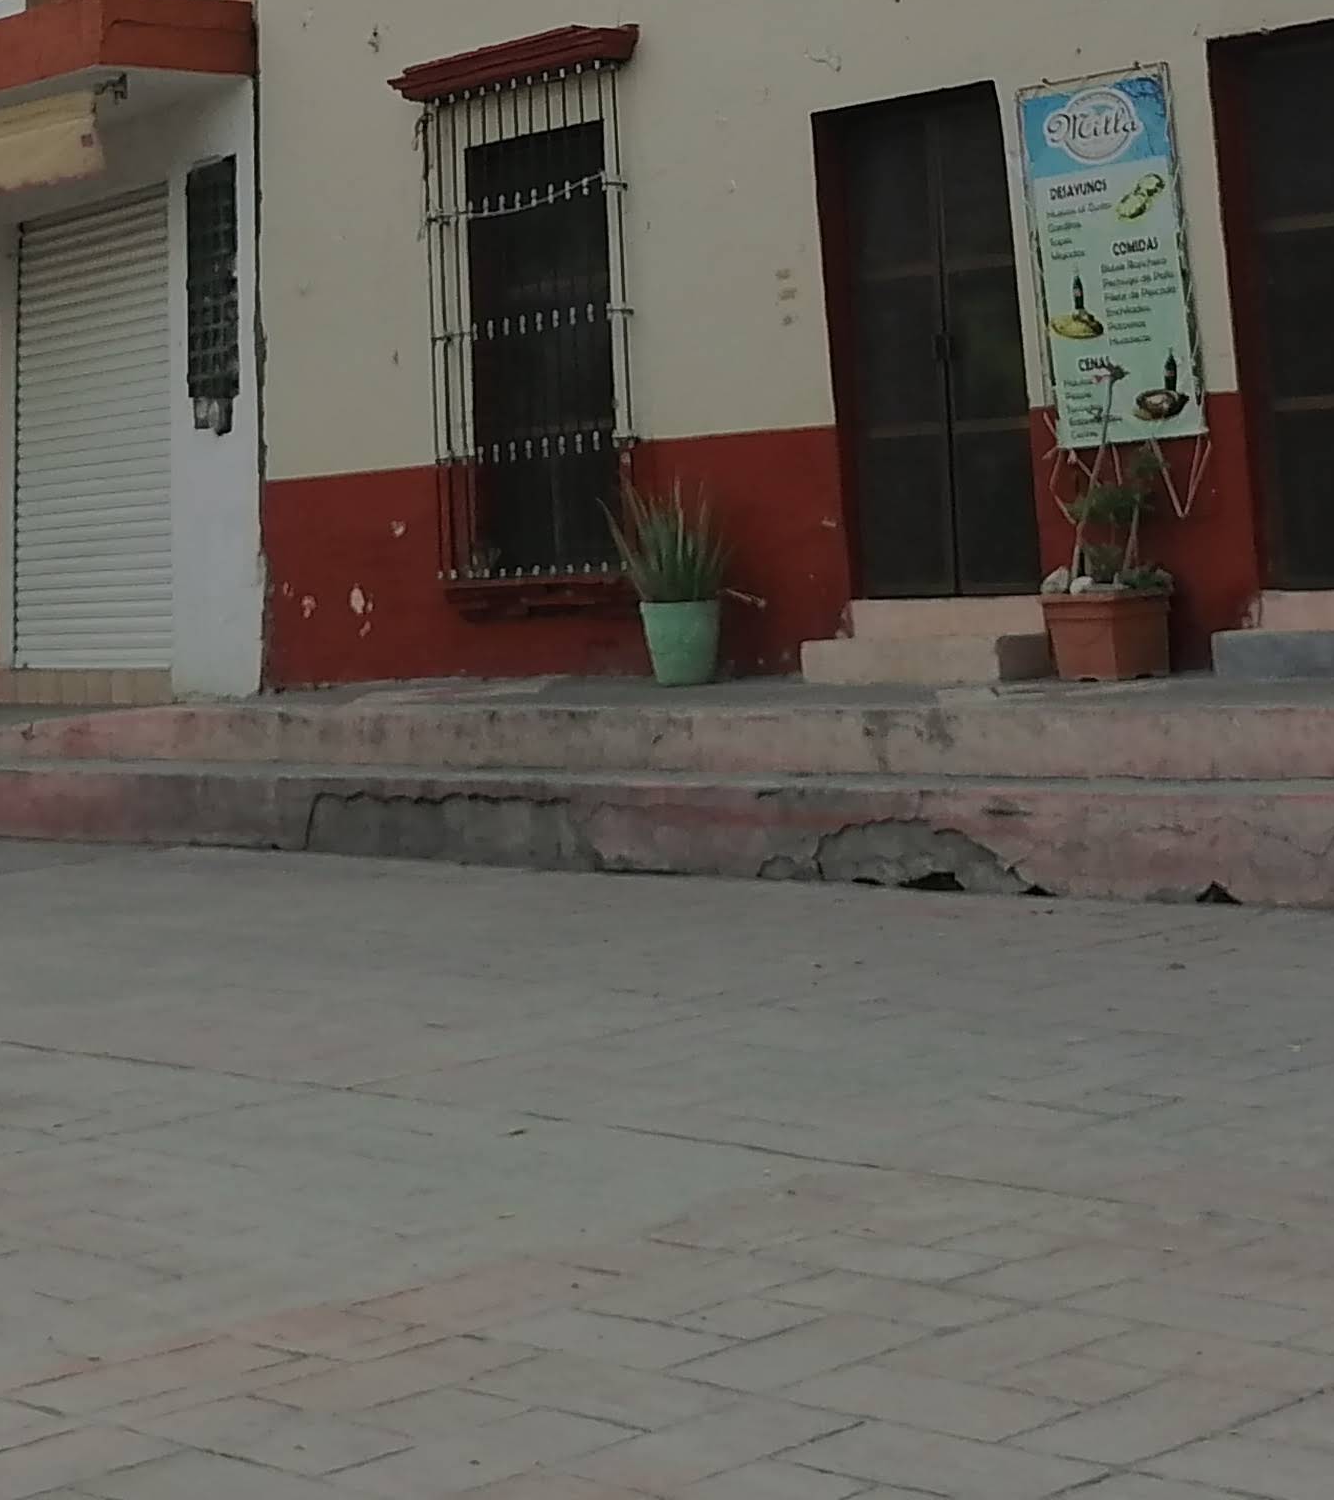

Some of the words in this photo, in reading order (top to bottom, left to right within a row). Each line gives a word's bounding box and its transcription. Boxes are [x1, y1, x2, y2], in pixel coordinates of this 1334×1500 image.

[1046, 106, 1138, 143] Mitla
[1049, 178, 1108, 201] DESAYUNOS
[1112, 236, 1159, 256] COMIDAS
